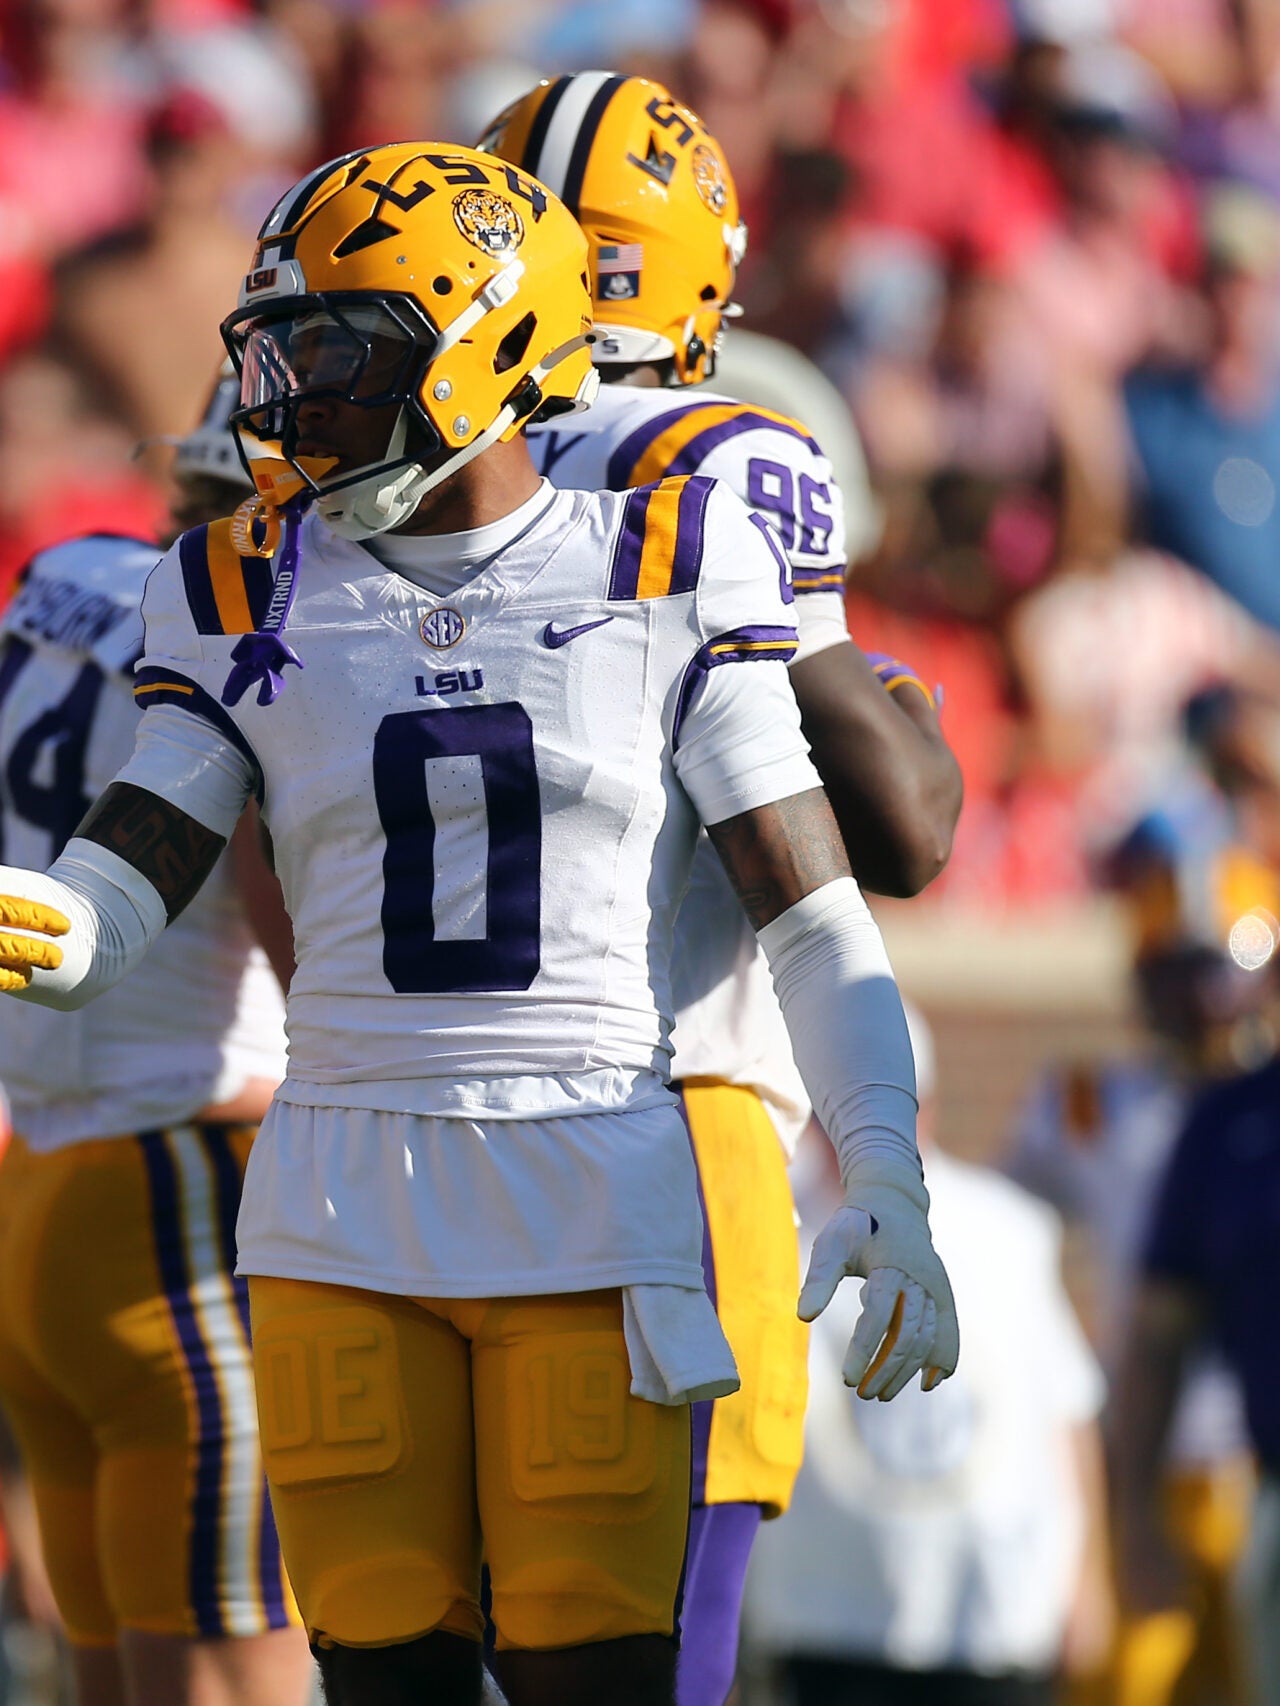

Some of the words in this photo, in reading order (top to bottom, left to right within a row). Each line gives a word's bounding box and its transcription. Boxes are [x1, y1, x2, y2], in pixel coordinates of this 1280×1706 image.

[626, 97, 711, 188] LS
[360, 154, 547, 214] LSU
[246, 267, 278, 294] LSU
[747, 457, 834, 556] 96
[263, 570, 294, 630] NXTRND
[422, 608, 463, 647] SEC
[414, 668, 485, 697] LSU
[372, 700, 543, 995] 0
[527, 1354, 624, 1467] 19
